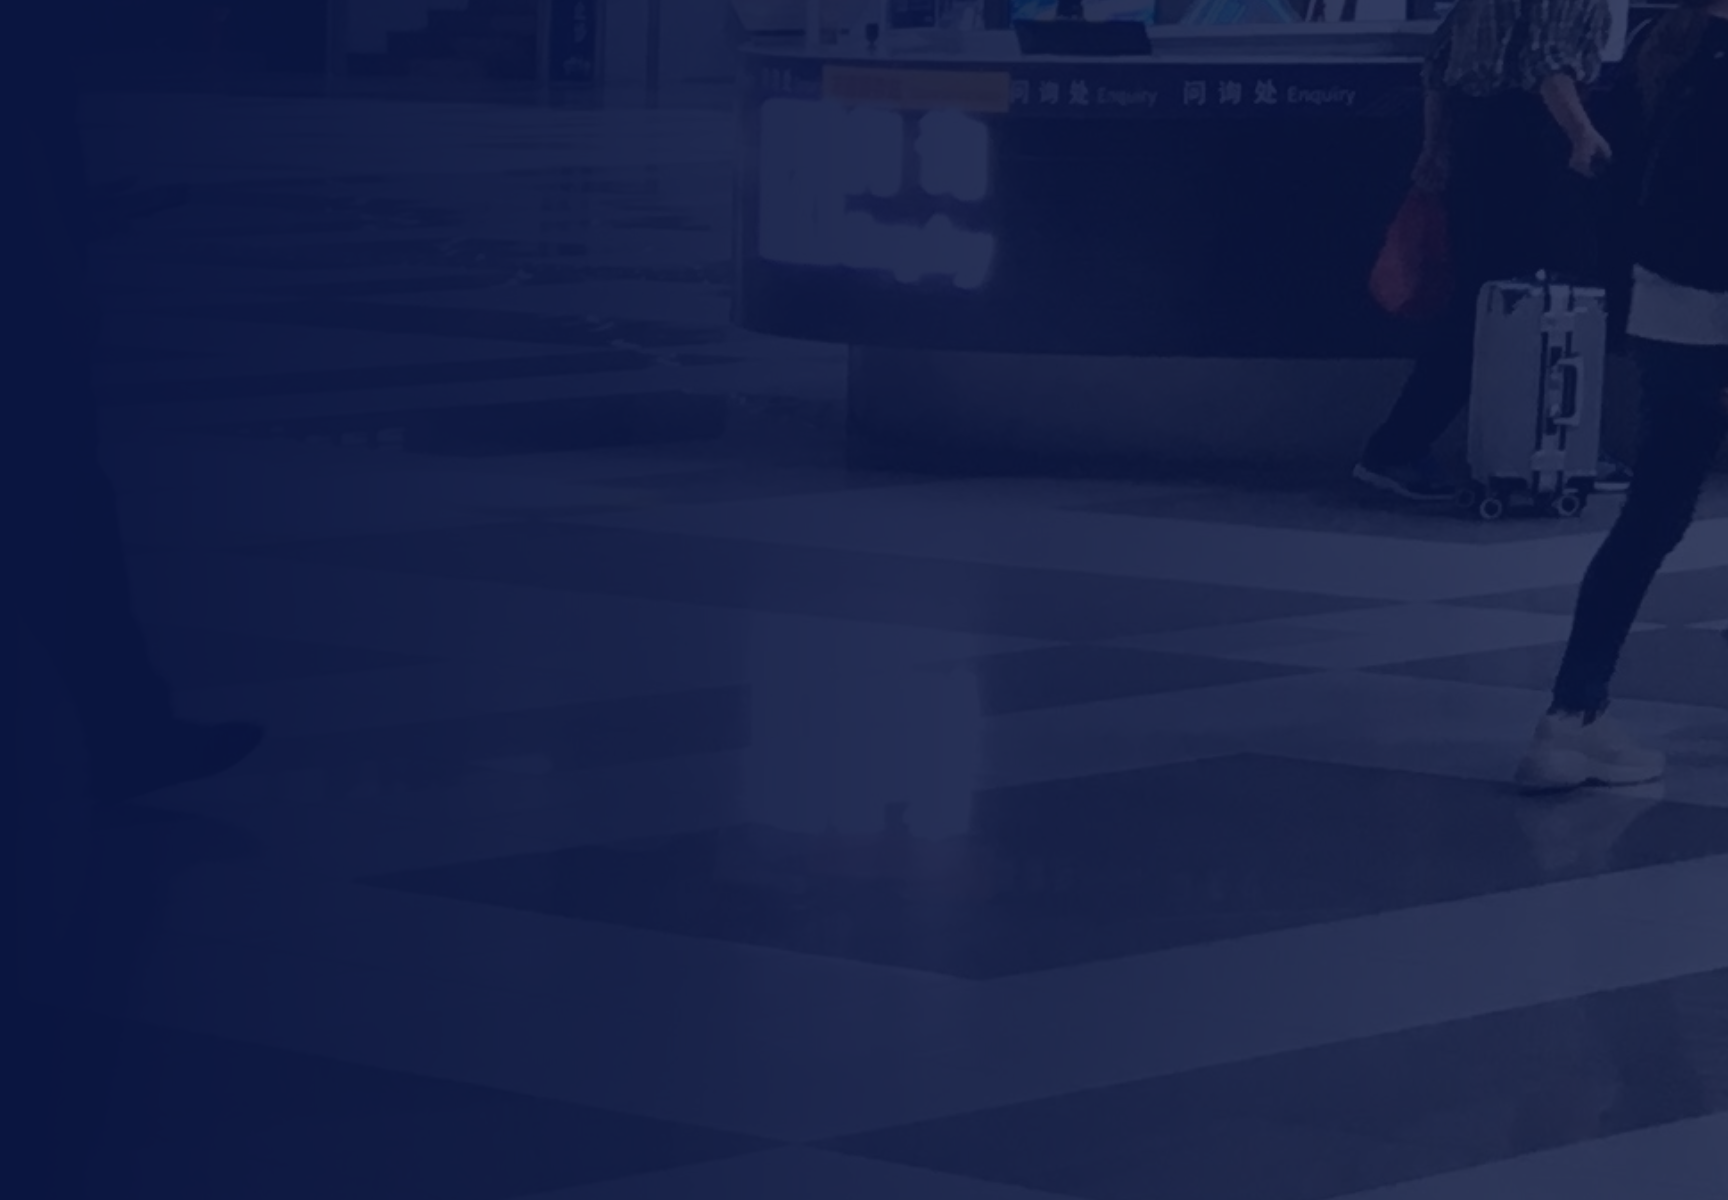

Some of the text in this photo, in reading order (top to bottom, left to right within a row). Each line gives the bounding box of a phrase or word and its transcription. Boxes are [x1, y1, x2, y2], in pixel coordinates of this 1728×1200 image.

[1183, 78, 1278, 107] 问询处
[1286, 84, 1356, 108] Enquiry
